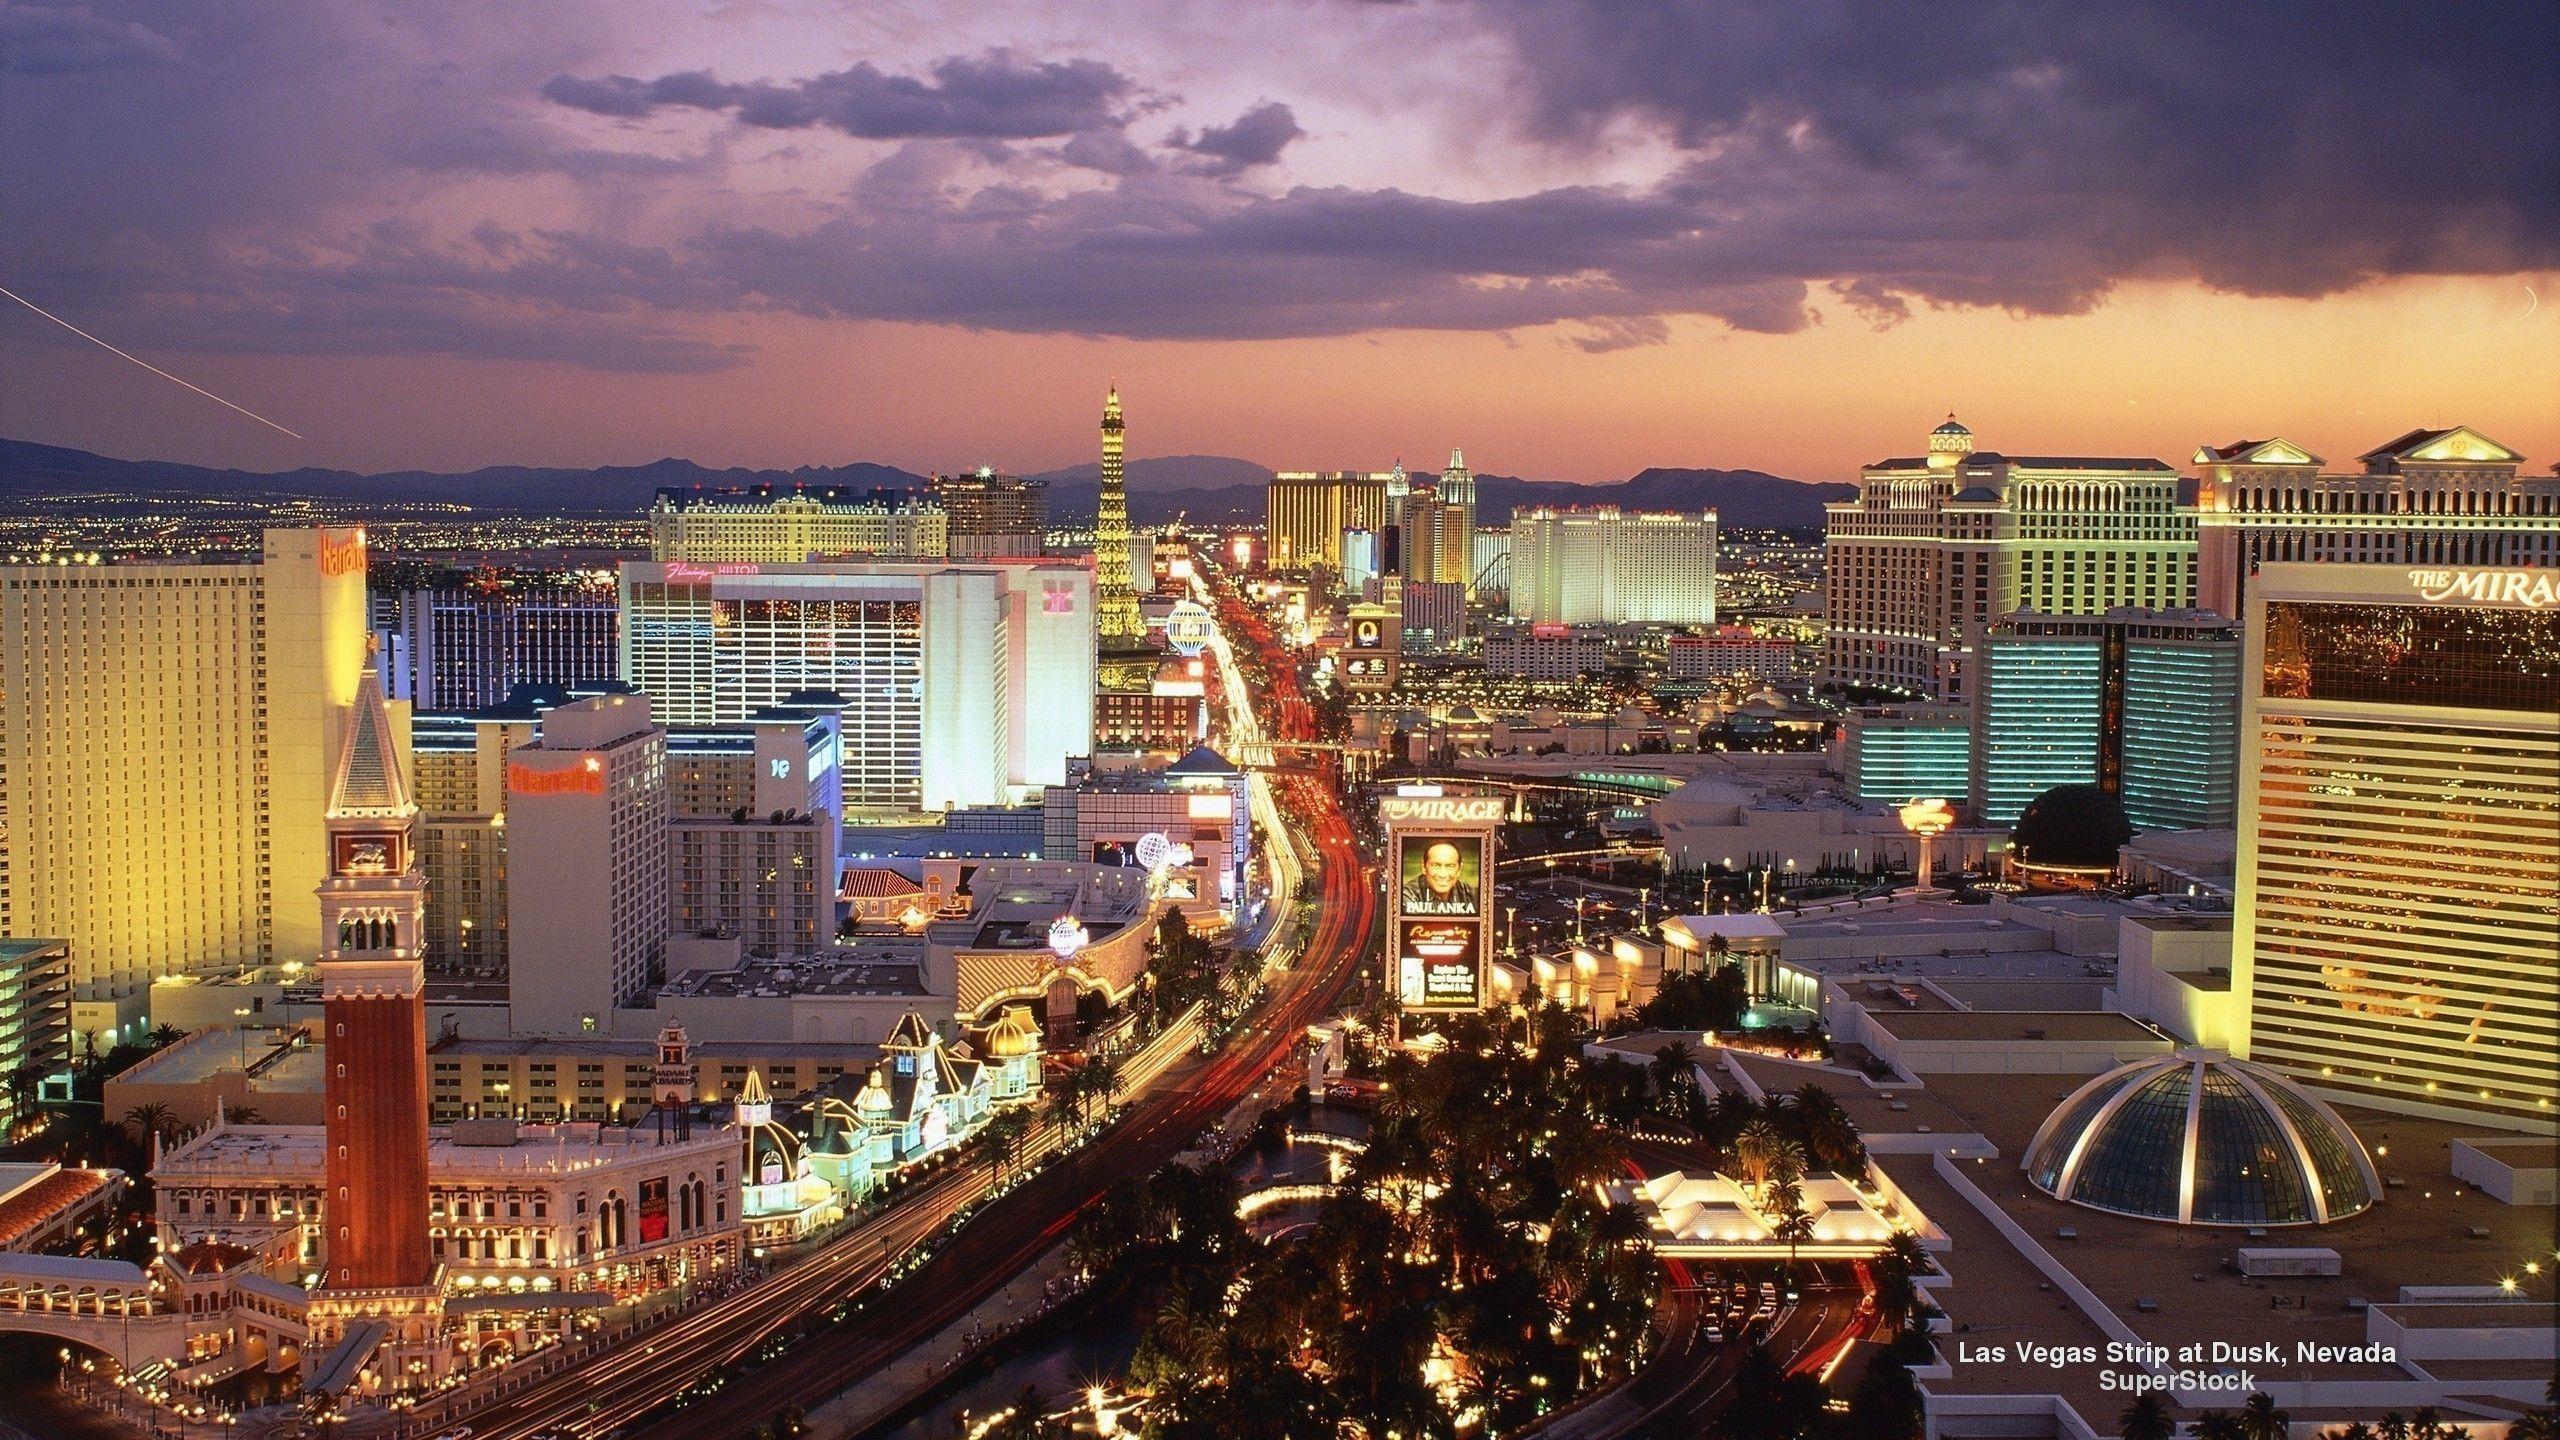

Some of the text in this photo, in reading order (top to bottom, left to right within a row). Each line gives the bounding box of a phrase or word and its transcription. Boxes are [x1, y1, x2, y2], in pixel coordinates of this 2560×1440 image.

[1153, 543, 1189, 556] MGM
[666, 563, 759, 579] Flamingo HILTON
[2408, 570, 2560, 607] THE MIRA
[1382, 801, 1502, 822] THE MIRAGE
[1406, 902, 1476, 914] PAUL ANKA
